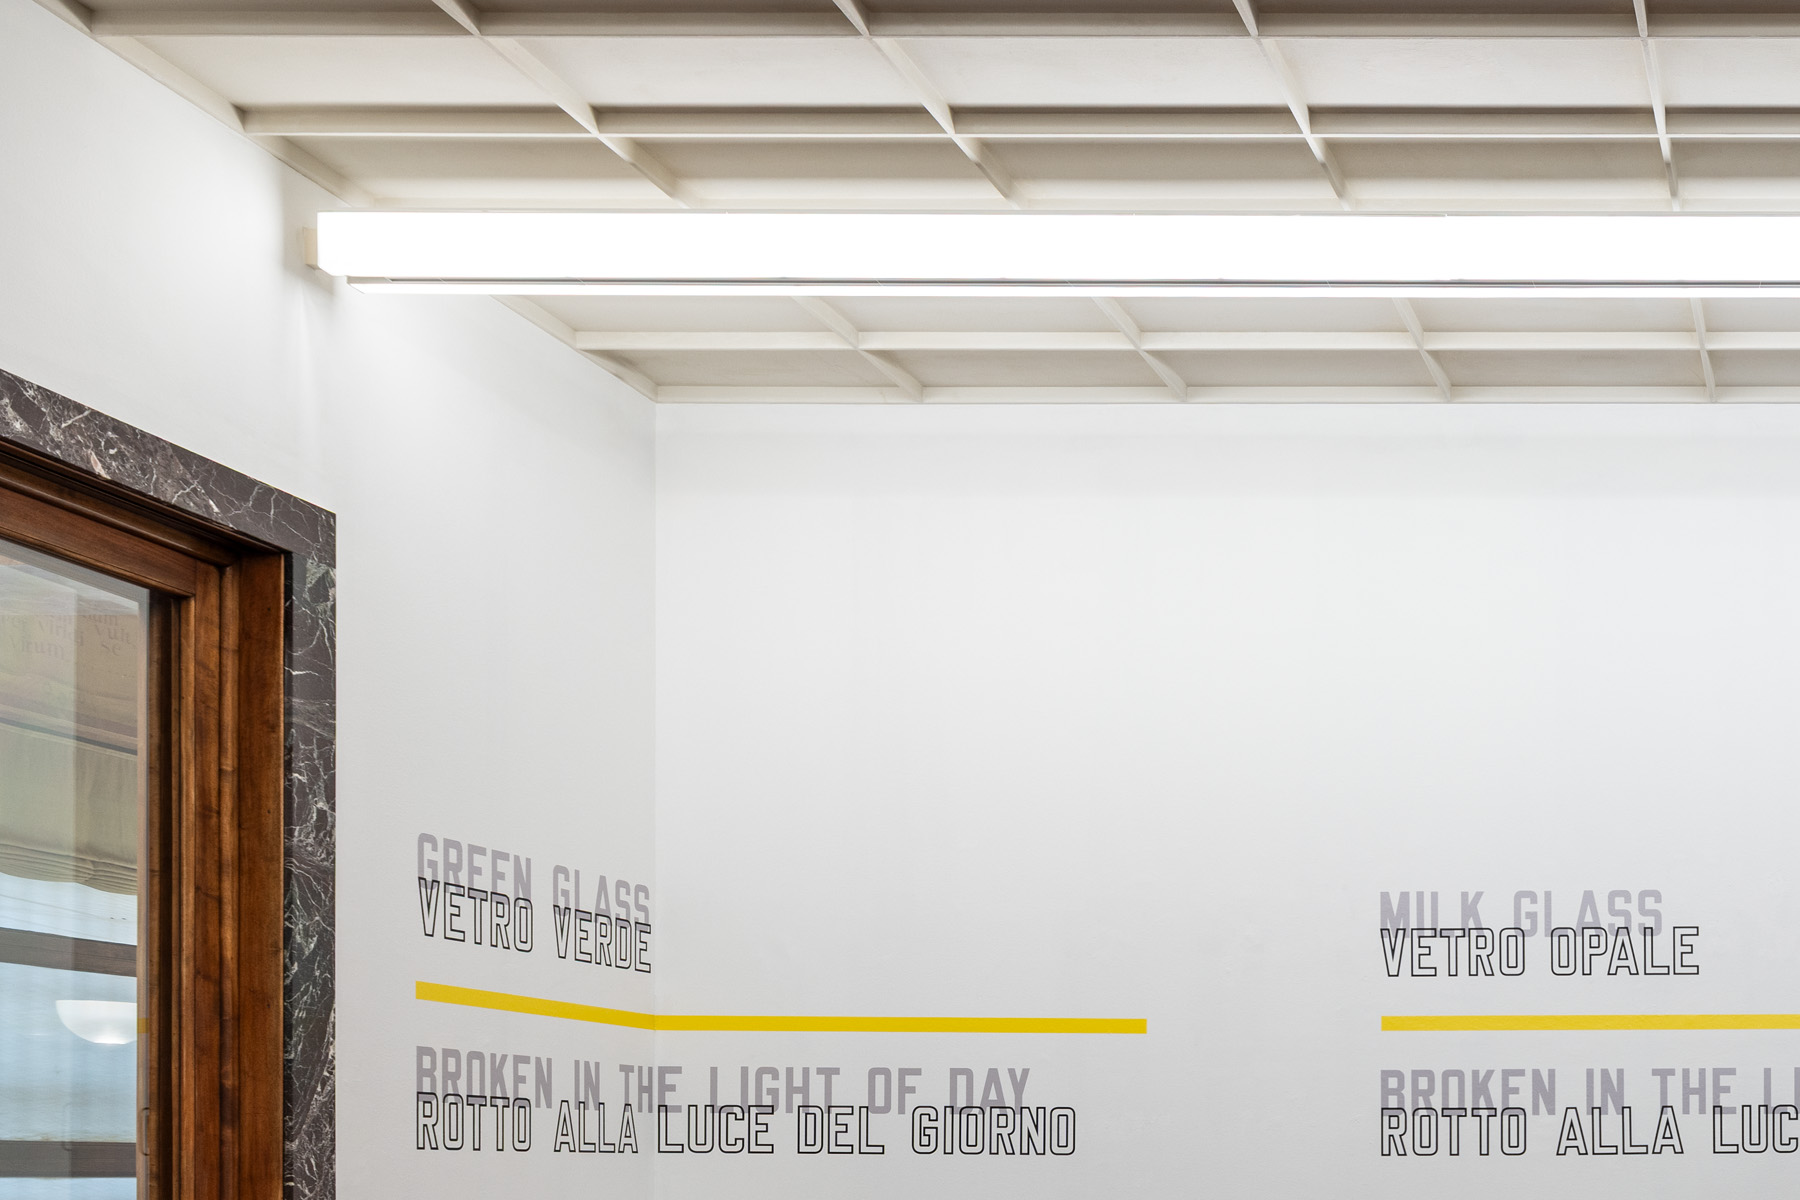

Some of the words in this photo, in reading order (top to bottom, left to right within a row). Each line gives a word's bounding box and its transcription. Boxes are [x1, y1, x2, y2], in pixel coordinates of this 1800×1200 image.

[417, 833, 532, 912] GREEN
[552, 864, 651, 932] GLASS
[417, 876, 534, 954] VETRO
[552, 904, 652, 974] VERDE
[1380, 890, 1485, 939] MILK
[1513, 889, 1663, 938] GLASS
[1380, 927, 1526, 977] VETRO
[1550, 926, 1700, 976] OPALE
[416, 1046, 553, 1110] BROKEN
[574, 1059, 600, 1112] IN
[620, 1064, 683, 1113] THE
[709, 1066, 840, 1114] LIGHT
[868, 1067, 922, 1115] OF
[949, 1067, 1030, 1115] DAY
[1380, 1068, 1558, 1116] BROKEN
[1585, 1068, 1625, 1115] IN
[1651, 1067, 1737, 1115] THE
[416, 1092, 532, 1152] ROTTO
[554, 1100, 639, 1154] ALLA
[657, 1104, 775, 1155] LUCE
[797, 1105, 885, 1156] DEL
[911, 1106, 1076, 1156] GIORNO
[1380, 1107, 1527, 1157] ROTTO
[1556, 1106, 1684, 1156] ALLA
